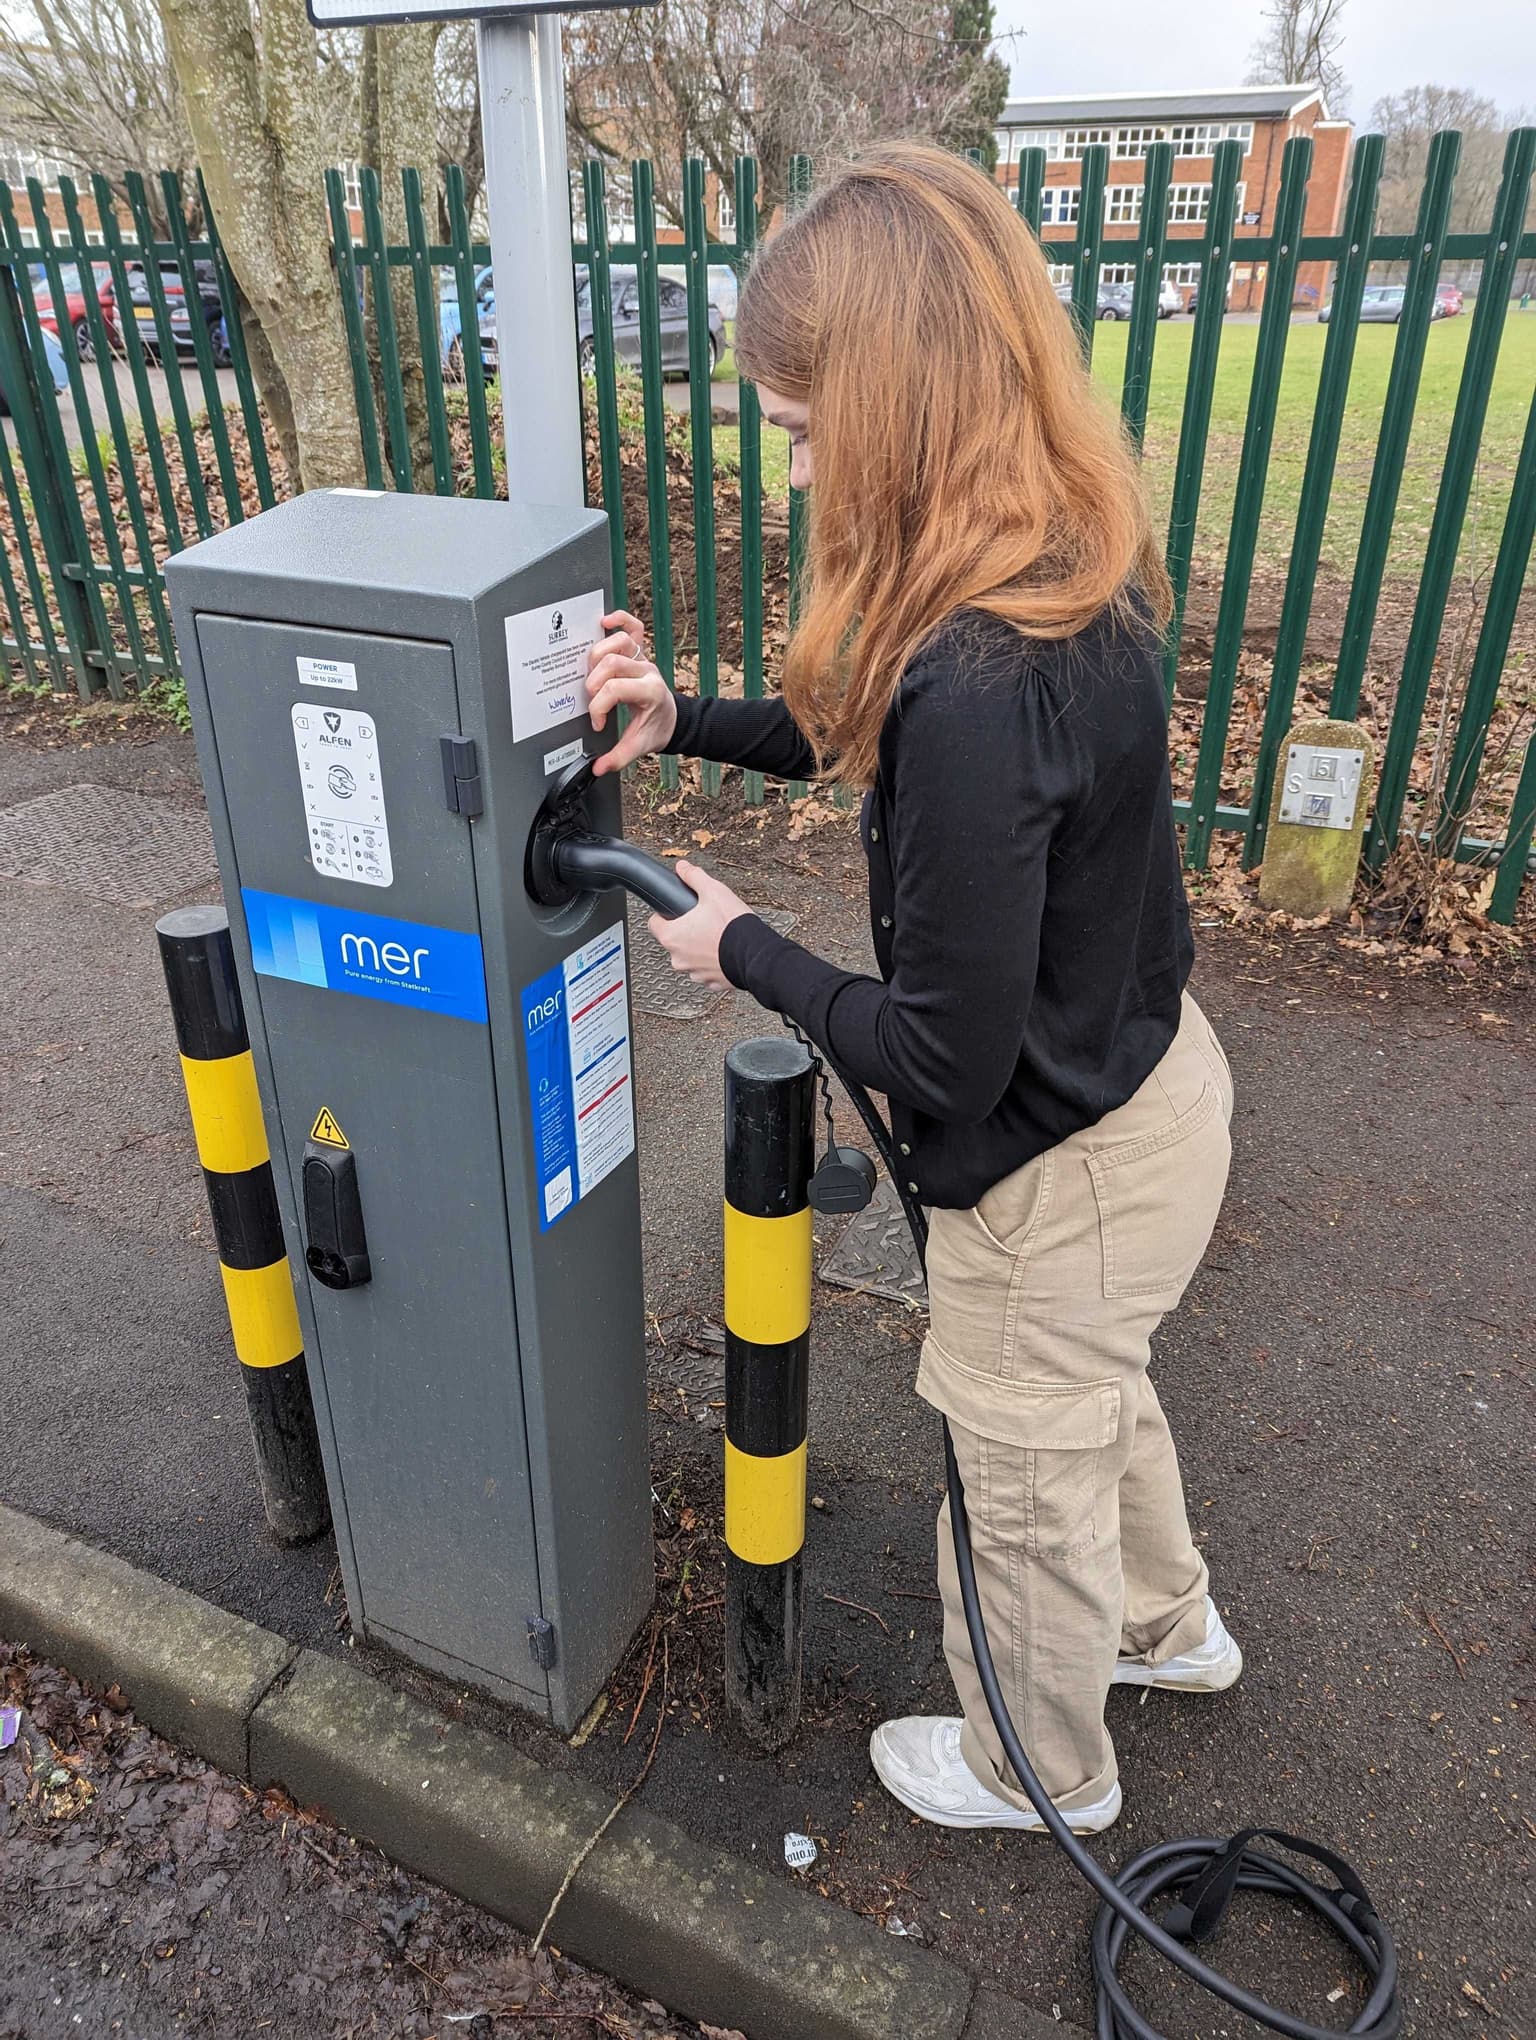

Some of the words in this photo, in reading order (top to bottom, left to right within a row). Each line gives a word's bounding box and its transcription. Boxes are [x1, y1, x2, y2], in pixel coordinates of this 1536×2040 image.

[548, 628, 569, 641] SURREY
[313, 662, 338, 673] POWER
[310, 674, 319, 683] Up
[319, 734, 353, 748] ALFEN
[1316, 759, 1330, 778] 5
[1287, 772, 1304, 794] S
[340, 932, 430, 980] mer
[344, 969, 360, 978] Pure
[360, 974, 383, 985] energy
[384, 978, 401, 987] from
[401, 981, 431, 993] Statkraft
[527, 989, 562, 1031] mer
[786, 1849, 818, 1863] orona
